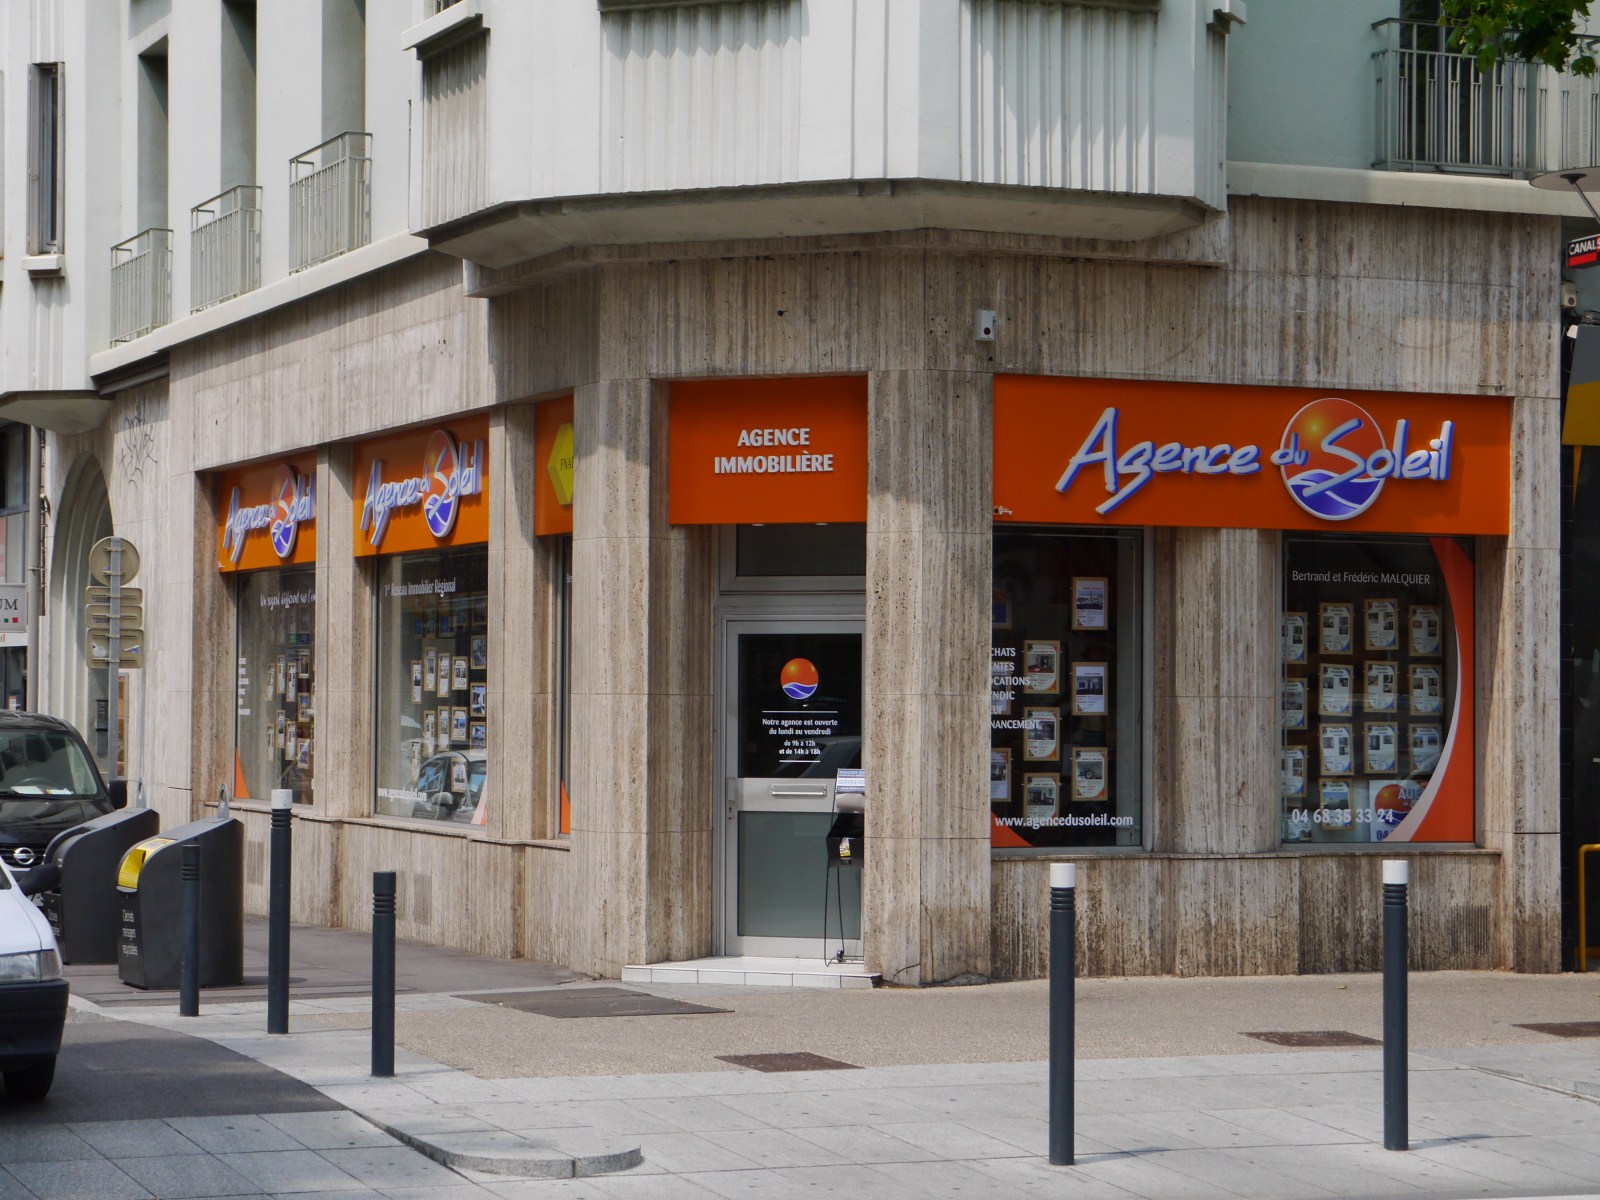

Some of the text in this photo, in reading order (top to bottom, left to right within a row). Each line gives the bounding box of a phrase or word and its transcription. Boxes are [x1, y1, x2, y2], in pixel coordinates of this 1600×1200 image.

[738, 428, 811, 447] AGENCE
[714, 450, 834, 474] IMMOBILIÈRE
[1055, 407, 1455, 514] Agence du Soleil
[361, 459, 424, 546] Agence
[428, 438, 483, 520] Soleil
[223, 486, 271, 563] Agence
[1293, 570, 1430, 586] Bertrand et Frédéric MALQUIER
[991, 662, 1015, 672] NTES
[991, 676, 1031, 686] CATIONS
[991, 690, 1016, 700] NDIC
[762, 718, 780, 726] Notre
[814, 718, 838, 726] ouverte
[995, 813, 1134, 829] www.agencedusoleil.com
[1291, 809, 1394, 823] 04 68 35 33 24
